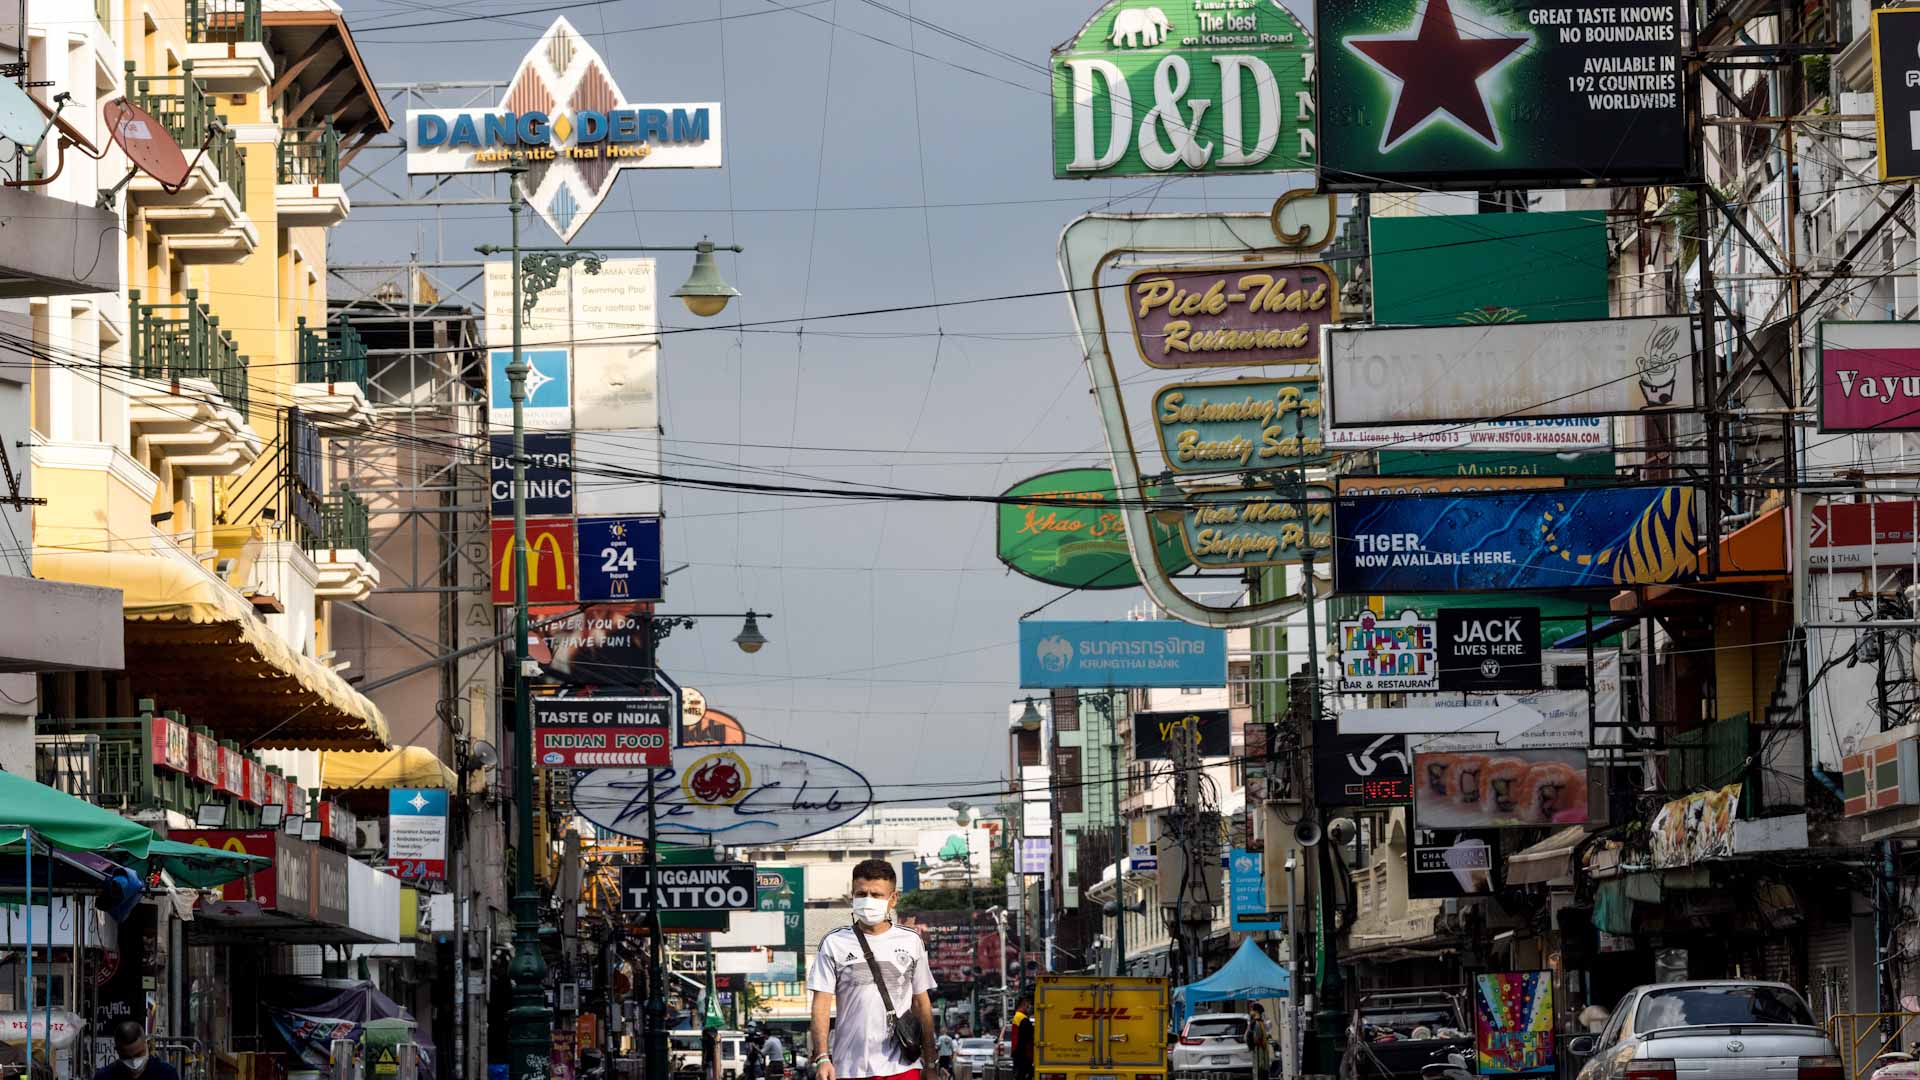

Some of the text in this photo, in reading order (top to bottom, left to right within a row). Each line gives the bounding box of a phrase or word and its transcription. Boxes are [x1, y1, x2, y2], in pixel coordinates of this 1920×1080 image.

[1199, 12, 1257, 32] The best
[1528, 7, 1674, 26] GREAT TASTE KNOWS
[1183, 33, 1293, 45] on Khaosan Road
[1559, 25, 1675, 43] NO BOUNDARIES
[1584, 56, 1675, 75] AVAILABLE IN
[1568, 74, 1676, 93] 192 COUNTRIES
[1588, 92, 1677, 111] WORLDWIDE
[1064, 54, 1281, 171] D&D
[416, 107, 711, 147] DANG DERM
[566, 146, 599, 159] Thai
[605, 143, 652, 158] Hotel
[628, 266, 651, 276] VIEW
[582, 286, 625, 296] Swimming
[1136, 274, 1328, 318] Pick-Thai
[1163, 320, 1310, 355] Restaurant
[1535, 416, 1600, 428] BOOKING
[1359, 431, 1390, 442] License
[1470, 431, 1600, 443] WWW.NSTOUR-KHAOSAN.COM
[1176, 429, 1254, 466] Beauty
[1016, 508, 1084, 535] Khao
[1354, 533, 1426, 553] TIGER.
[601, 547, 637, 573] 24
[1354, 550, 1517, 568] NOW AVAILABLE HERE.
[1837, 552, 1861, 563] THAI
[587, 618, 613, 632] YOU
[1453, 619, 1523, 643] JACK
[563, 635, 595, 648] HAVE
[1079, 636, 1206, 658] ธนาคารกรุงไทย
[1453, 644, 1488, 656] LIVES
[1079, 658, 1180, 670] KRUNGTHAI BANK
[1343, 679, 1436, 690] BAR & RESTAURANT
[539, 711, 661, 725] TASTE OF INDIA
[544, 733, 665, 749] INDIAN FOOD
[401, 861, 427, 878] 24
[645, 869, 730, 885] IGGAINK
[629, 886, 749, 908] TATTOO
[1072, 1007, 1131, 1020] DHL
